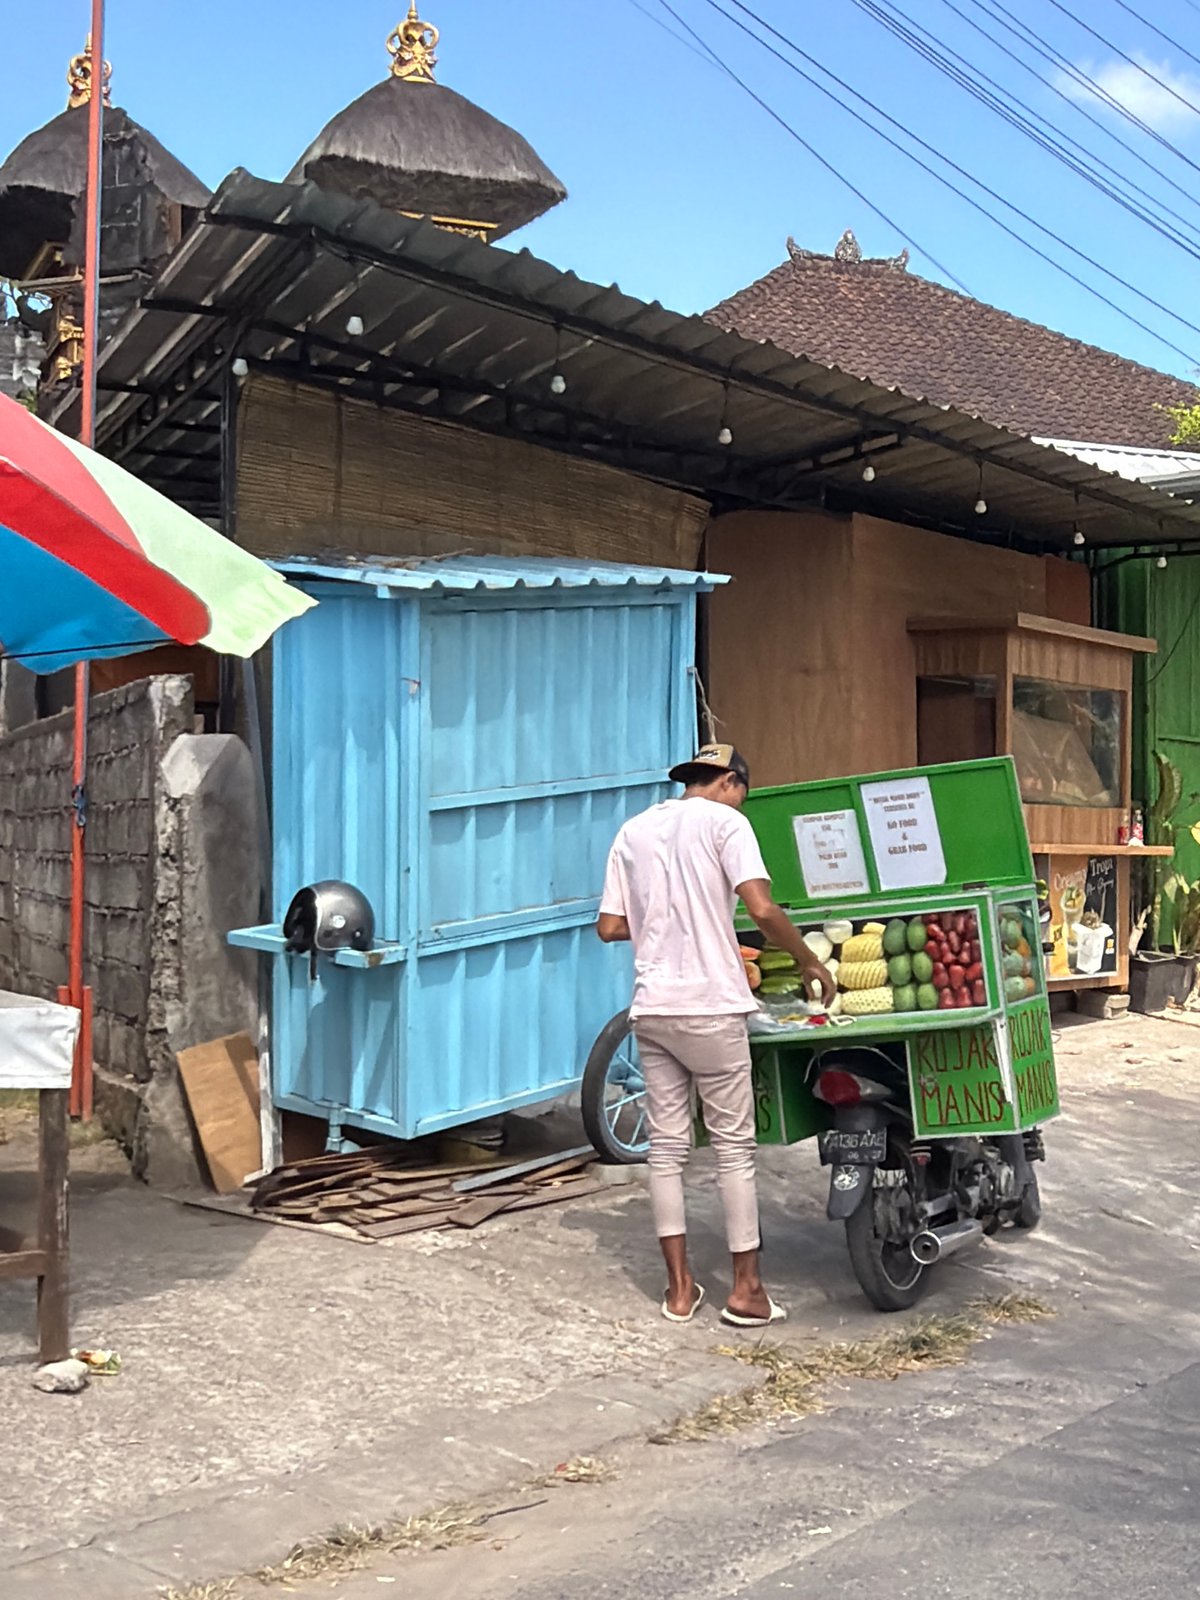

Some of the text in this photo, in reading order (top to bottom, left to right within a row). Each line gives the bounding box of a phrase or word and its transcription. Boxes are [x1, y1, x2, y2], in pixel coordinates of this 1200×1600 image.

[917, 1027, 1000, 1073] RUJAK
[920, 1080, 1004, 1126] MANIS
[1016, 1059, 1054, 1118] MANIS
